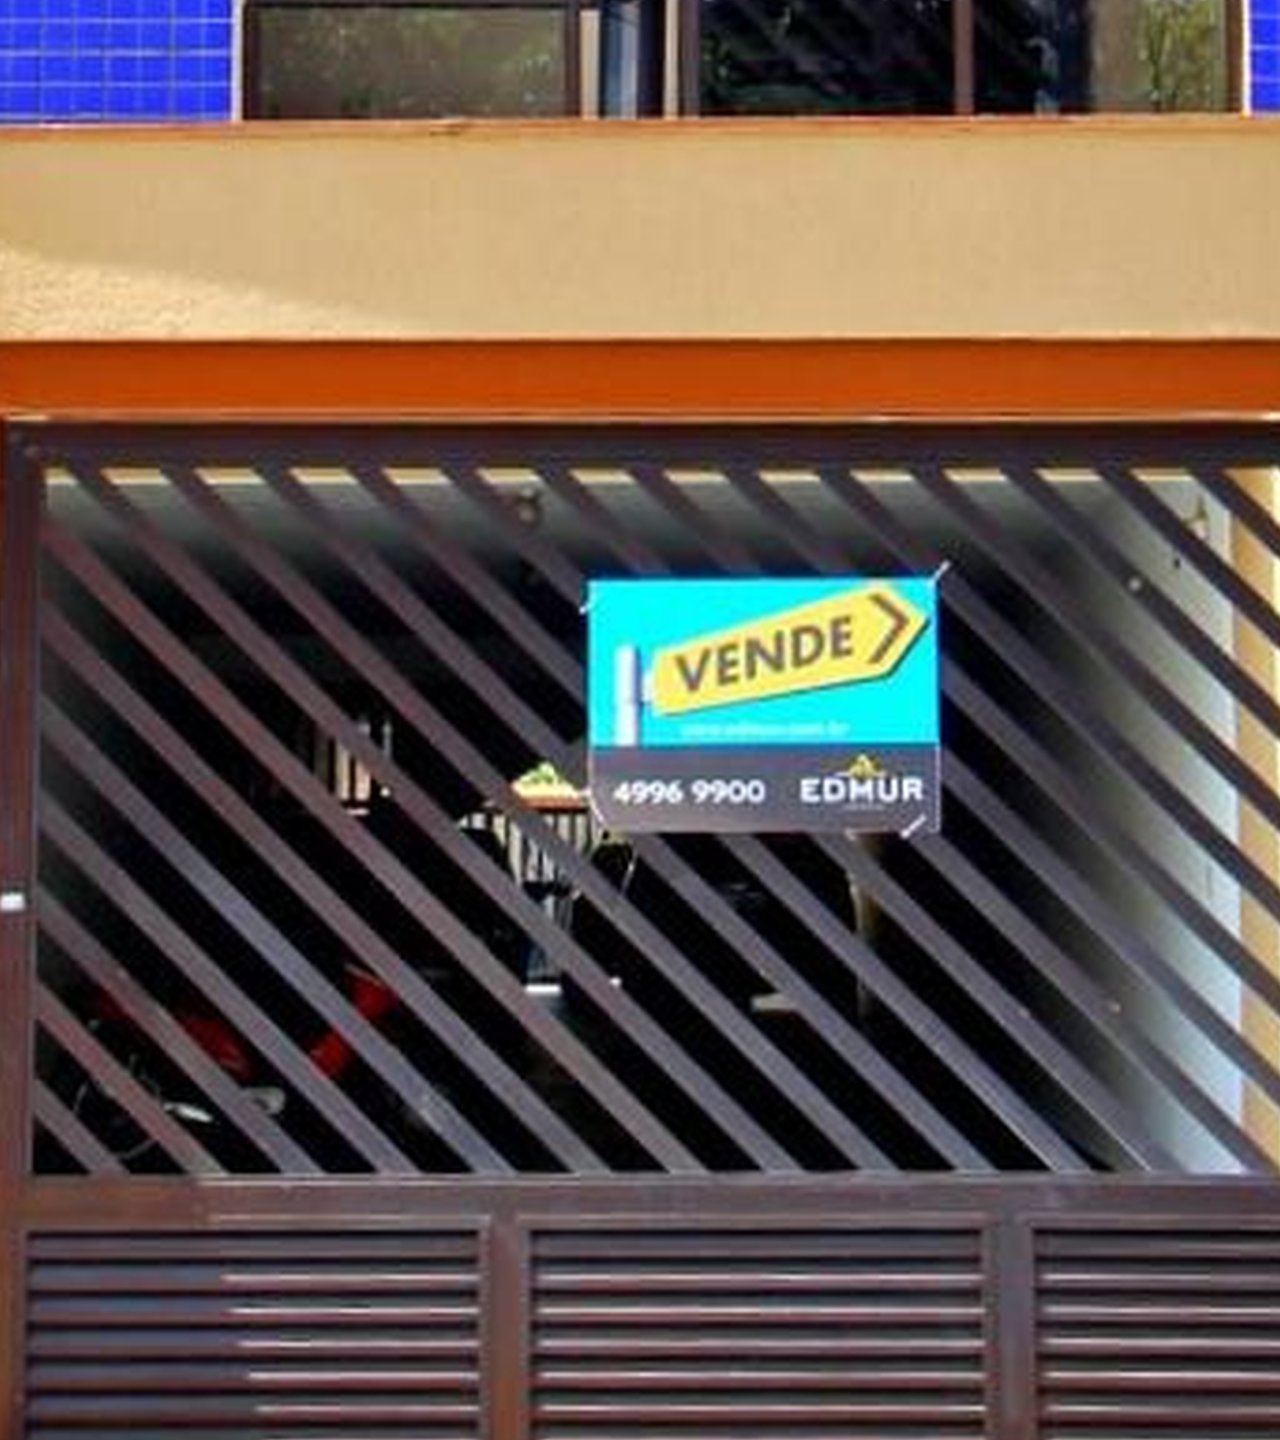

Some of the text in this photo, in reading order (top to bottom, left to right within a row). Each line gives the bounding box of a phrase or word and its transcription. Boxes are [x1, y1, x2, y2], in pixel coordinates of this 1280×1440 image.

[674, 615, 854, 693] VENDE
[614, 780, 766, 804] 4996 9900
[801, 778, 923, 803] EDMUR
